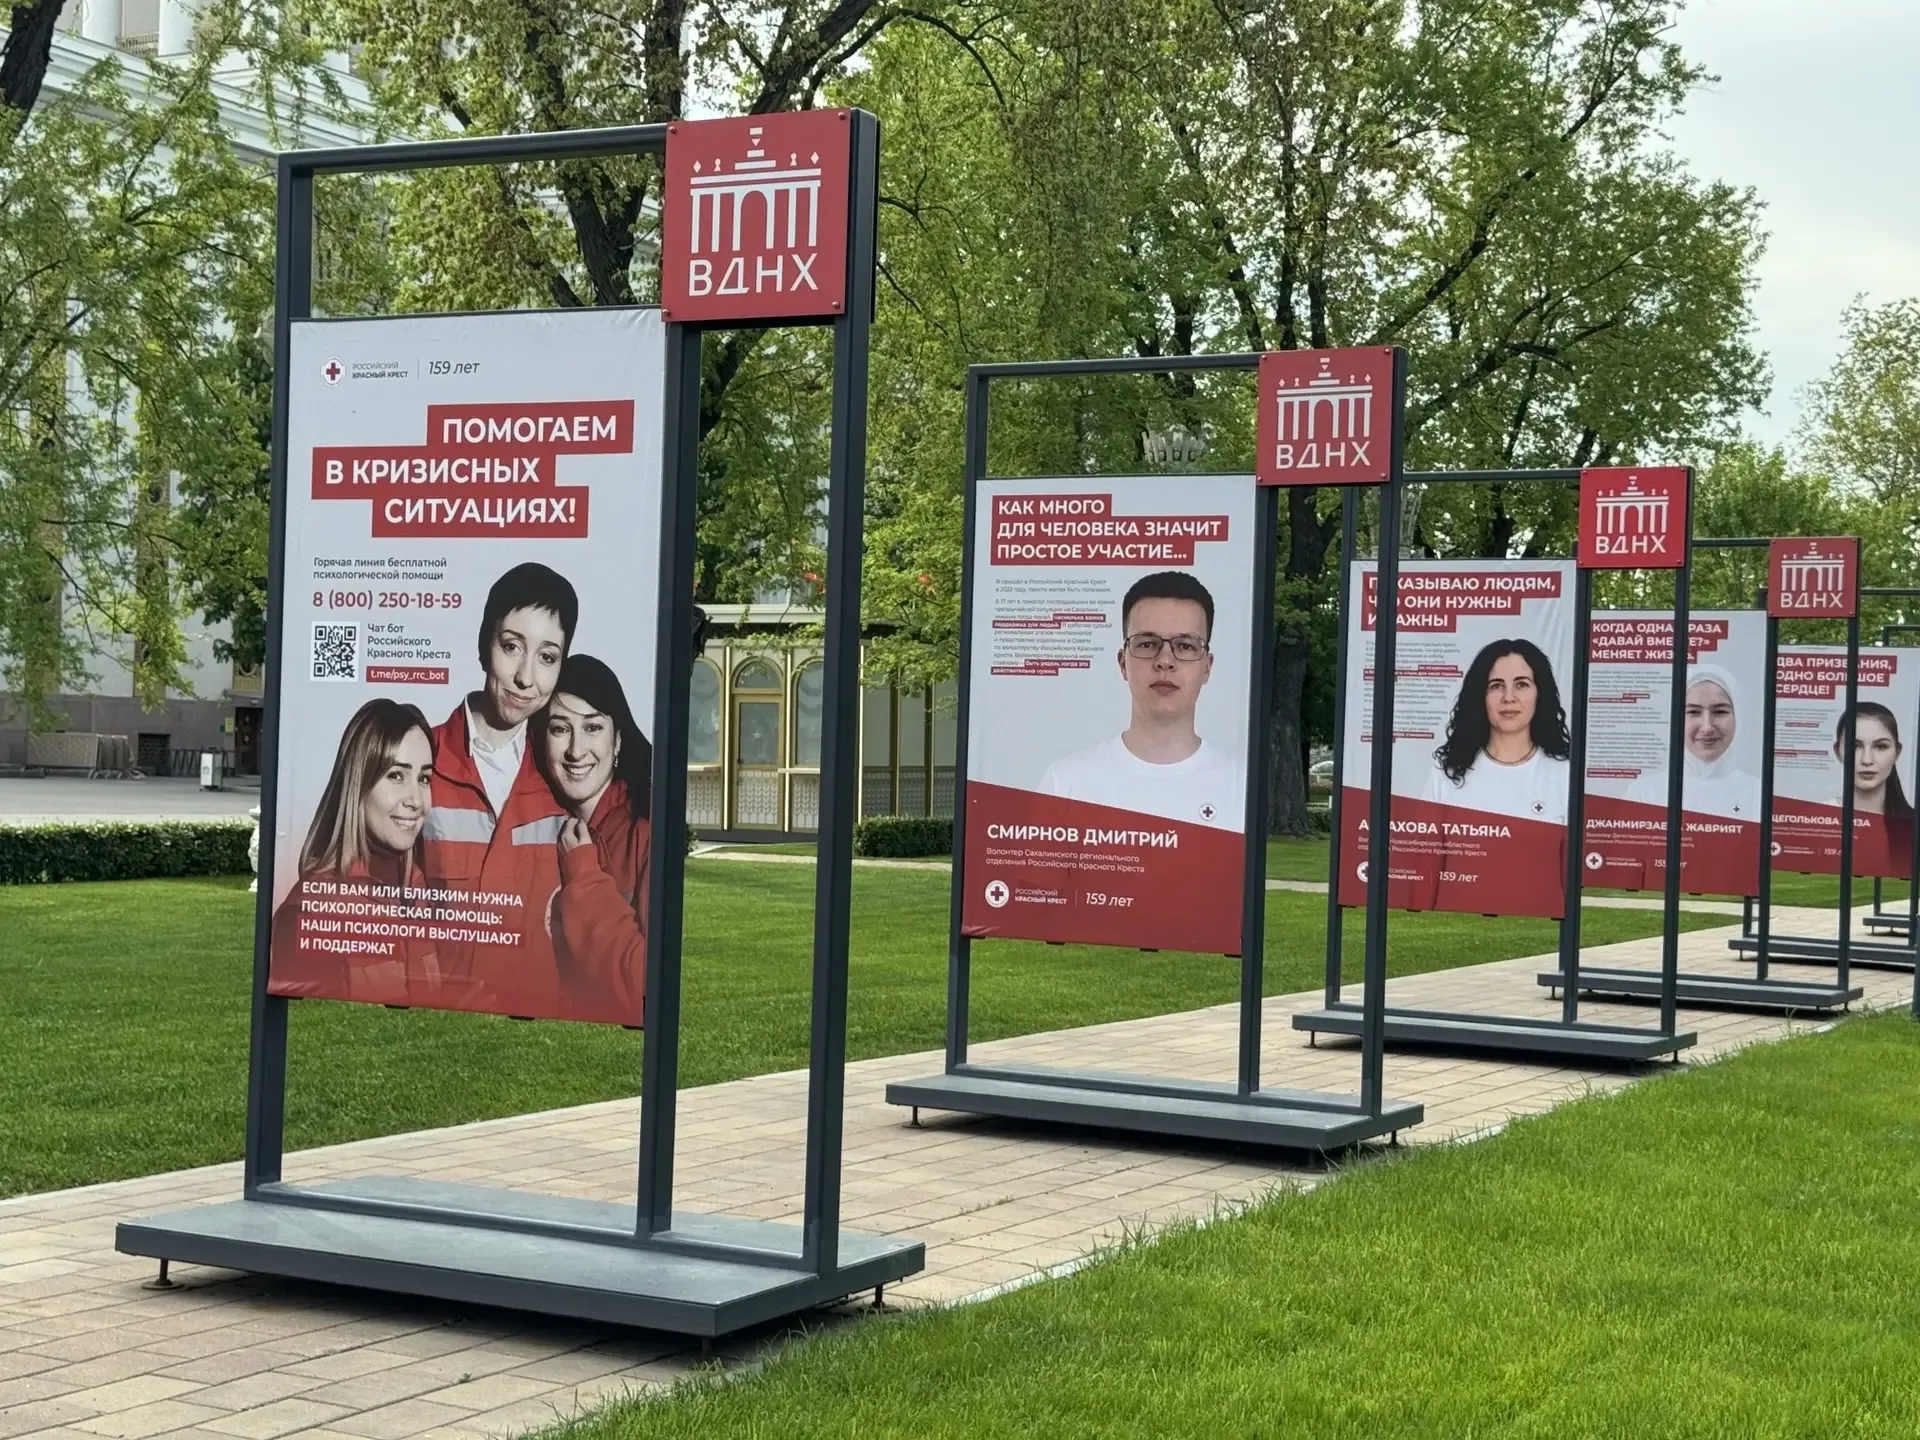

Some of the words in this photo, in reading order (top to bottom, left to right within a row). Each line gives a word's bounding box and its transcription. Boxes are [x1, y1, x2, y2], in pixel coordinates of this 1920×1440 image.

[688, 253, 819, 297] ВДНХ
[352, 361, 399, 370] РОССИЙСКИЙ
[429, 360, 450, 375] 159
[453, 362, 480, 375] лет
[352, 371, 386, 379] КРАСНЫЙ
[442, 415, 617, 444] ПОМОГАЕМ
[1275, 440, 1371, 469] ВДНХ
[325, 459, 344, 484] В
[352, 457, 540, 484] КРИЗИСНЫХ
[384, 498, 576, 528] СИТУАЦИЯХ!
[998, 500, 1034, 515] КАК
[1039, 499, 1105, 515] МНОГО
[997, 521, 1035, 539] ДЛЯ
[1040, 521, 1140, 537] ЧЕЛОВЕКА
[1144, 520, 1222, 536] ЗНАЧИТ
[997, 544, 1082, 559] ПРОСТОЕ
[1087, 543, 1187, 559] УЧАСТИЕ...
[1595, 535, 1667, 554] ВДНХ
[313, 557, 351, 568] Горячая
[354, 559, 385, 567] линия
[388, 557, 447, 568] бесплатной
[313, 570, 400, 580] психологической
[402, 571, 444, 580] помощи
[1369, 576, 1479, 591] ПКАЗЫВАЮ
[1483, 576, 1555, 592] ЛЮДЯМ,
[312, 591, 323, 607] 8
[328, 589, 373, 610] (800)
[378, 592, 462, 608] 250-18-59
[1404, 596, 1441, 609] ОНИ
[1446, 596, 1512, 609] НУЖНЫ
[1780, 592, 1843, 608] ВДНХ
[367, 623, 386, 632] Чат
[387, 623, 404, 633] бот
[1396, 614, 1448, 627] АЖНЫ
[1592, 623, 1634, 634] КОГДА
[1636, 623, 1674, 635] ОДНА
[1688, 623, 1722, 633] РАЗА
[367, 635, 431, 646] Российского
[1592, 634, 1643, 647] «ДАВАЙ
[367, 649, 413, 659] Красного
[416, 649, 451, 660] Креста
[1592, 649, 1642, 660] МЕНЯЕТ
[1776, 657, 1803, 668] ДВА
[370, 669, 445, 681] t.me/psy_rrc_bot
[1776, 671, 1814, 681] ОДНО
[1776, 683, 1829, 695] СЕРДЦЕ!
[1442, 823, 1511, 838] ТАТЬЯНА
[1686, 822, 1743, 834] ЖАВРИЯТ
[986, 824, 1079, 843] СМИРНОВ
[1083, 828, 1179, 849] ДМИТРИЙ
[986, 847, 1023, 857] Волонтер
[1025, 848, 1078, 859] Сахалинского
[1079, 852, 1140, 863] регионального
[1433, 848, 1463, 856] Красного
[1464, 849, 1487, 857] Креста
[985, 858, 1026, 867] отделения
[1027, 859, 1077, 869] Российского
[1078, 862, 1116, 872] Красного
[1117, 864, 1145, 873] Креста
[1439, 871, 1456, 881] 159
[1457, 873, 1478, 882] лет
[302, 881, 337, 895] ЕСЛИ
[339, 884, 369, 897] ВАМ
[372, 885, 401, 898] ИЛИ
[403, 887, 469, 904] БЛИЗКИМ
[472, 892, 523, 908] НУЖНА
[1015, 888, 1058, 896] РОССИЙСКИЙ
[1085, 892, 1106, 905] 159
[1108, 895, 1134, 907] лет
[1047, 897, 1067, 905] КРЕСТ
[301, 900, 432, 920] ПСИХОЛОГИЧЕСКАЯ
[435, 908, 503, 926] ПОМОЩЬ:
[300, 918, 341, 932] НАШИ
[344, 921, 426, 938] ПСИХОЛОГИ
[428, 928, 521, 946] ВЫСЛУШАЮТ
[299, 937, 310, 950] И
[312, 938, 396, 956] ПОДДЕРЖАТ
